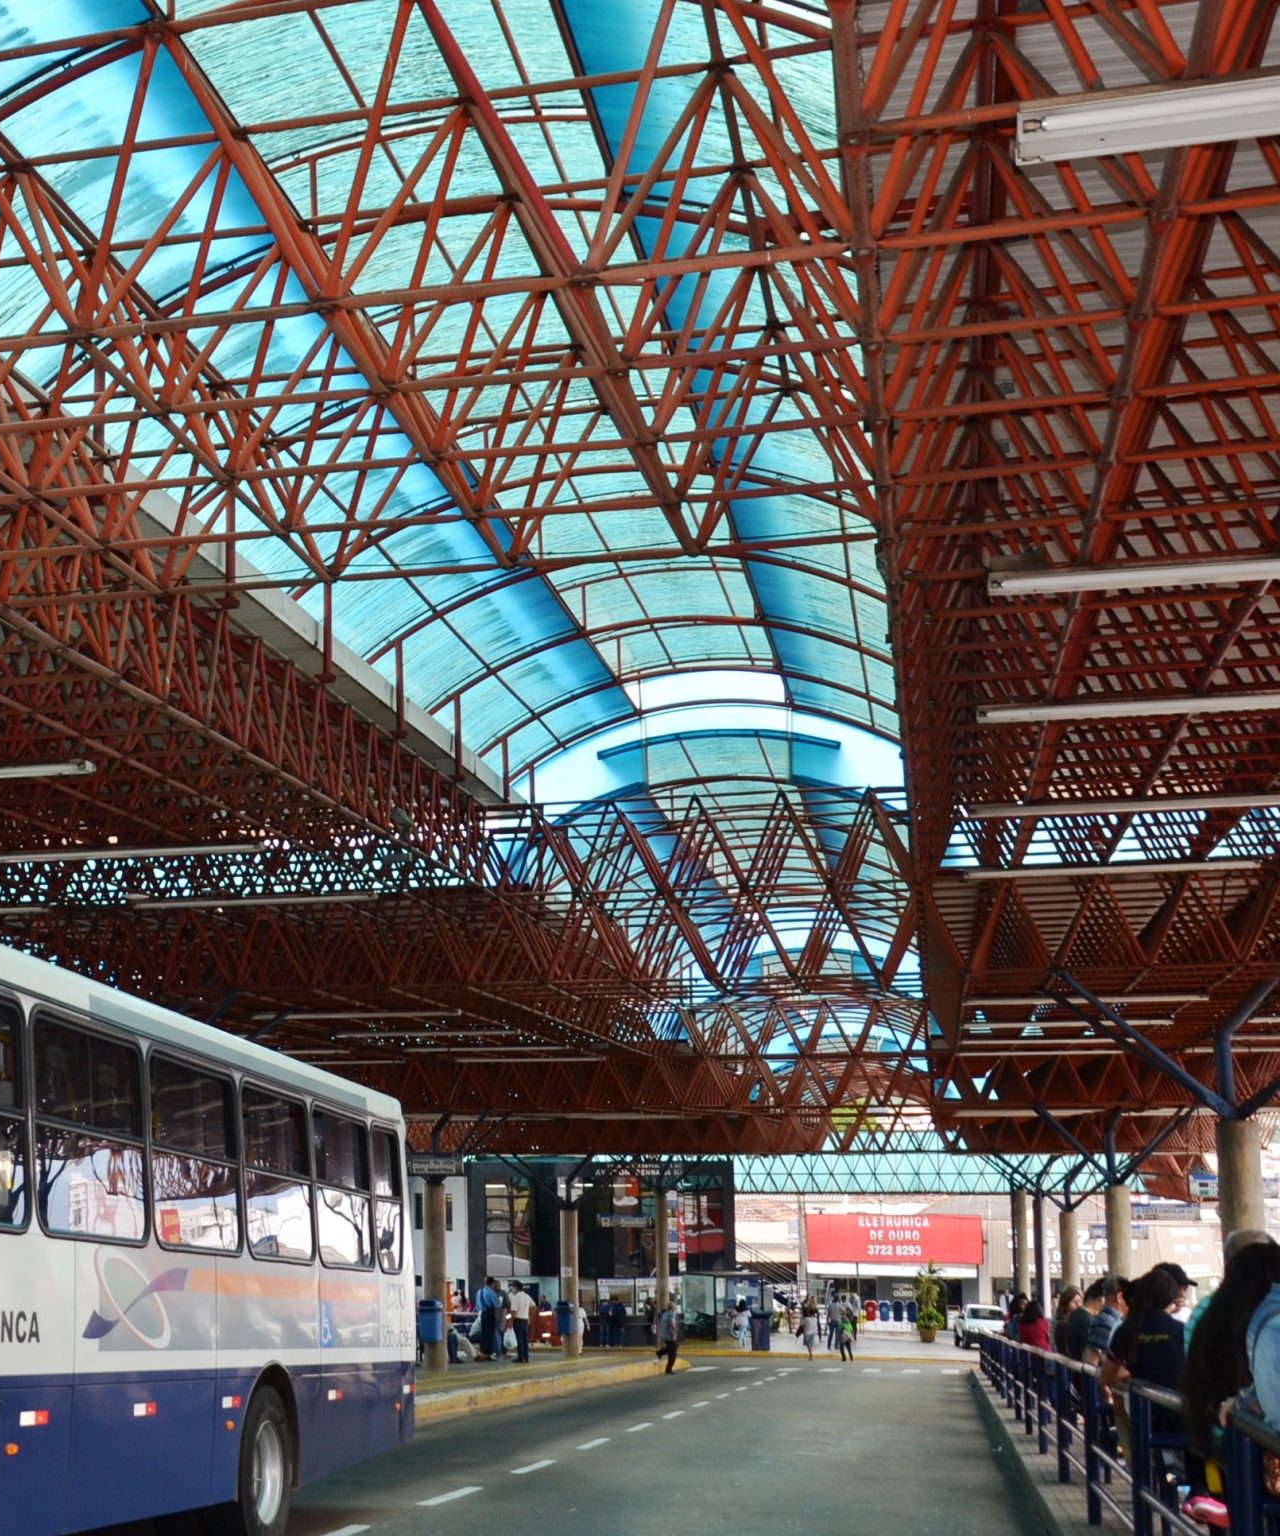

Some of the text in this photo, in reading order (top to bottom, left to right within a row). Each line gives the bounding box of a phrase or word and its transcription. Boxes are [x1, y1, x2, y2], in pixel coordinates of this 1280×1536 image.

[869, 1230, 920, 1241] DE OURO
[867, 1244, 923, 1256] 3722 8293
